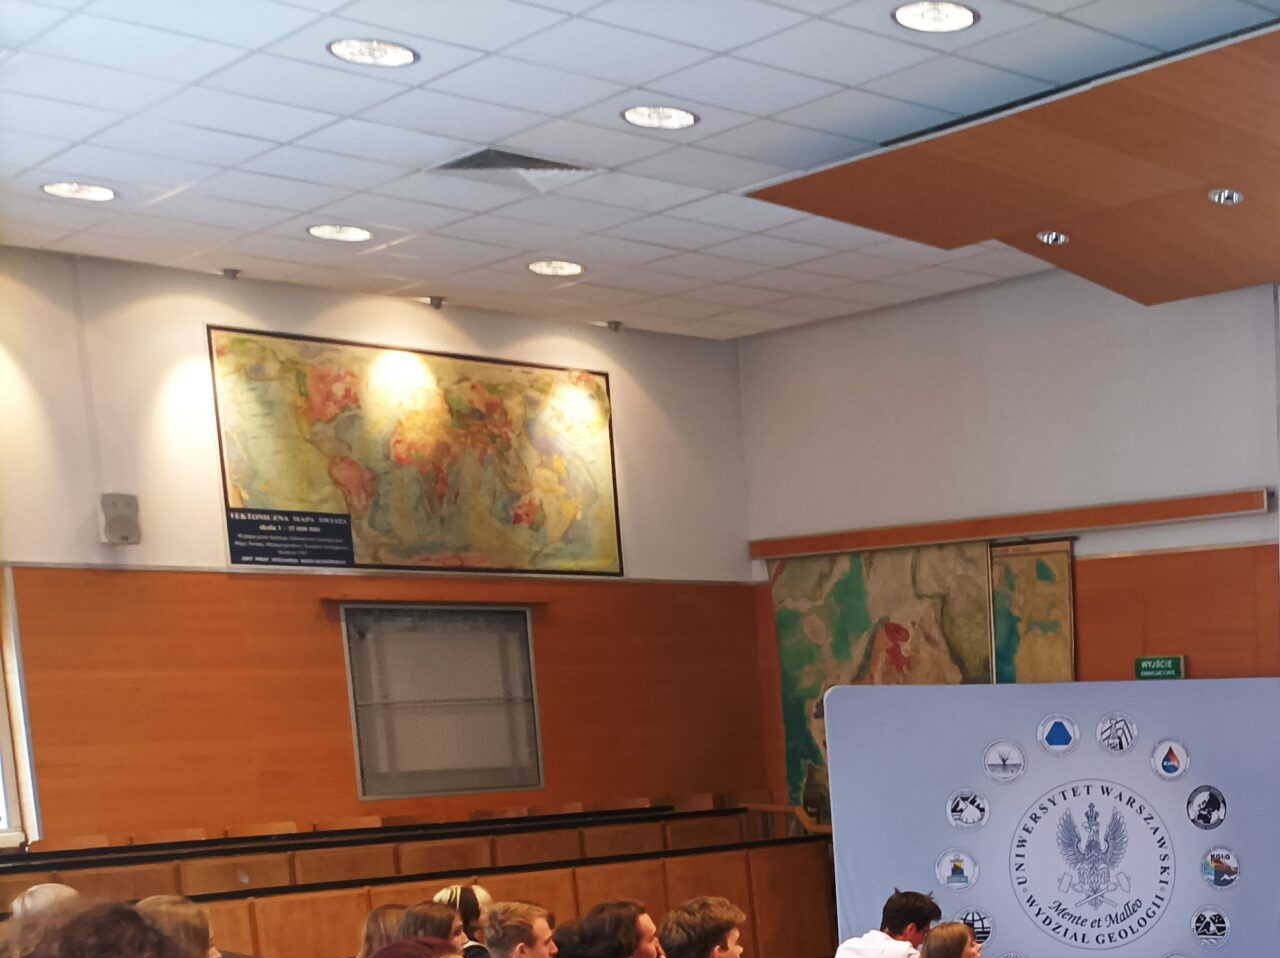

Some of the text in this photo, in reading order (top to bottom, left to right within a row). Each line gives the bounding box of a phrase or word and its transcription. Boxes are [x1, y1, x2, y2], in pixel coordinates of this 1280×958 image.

[1015, 784, 1170, 886] UNIWERSYTET WARSZAWSKI
[1049, 898, 1143, 929] Mente et Malleo
[1095, 894, 1165, 945] GEOLOGII
